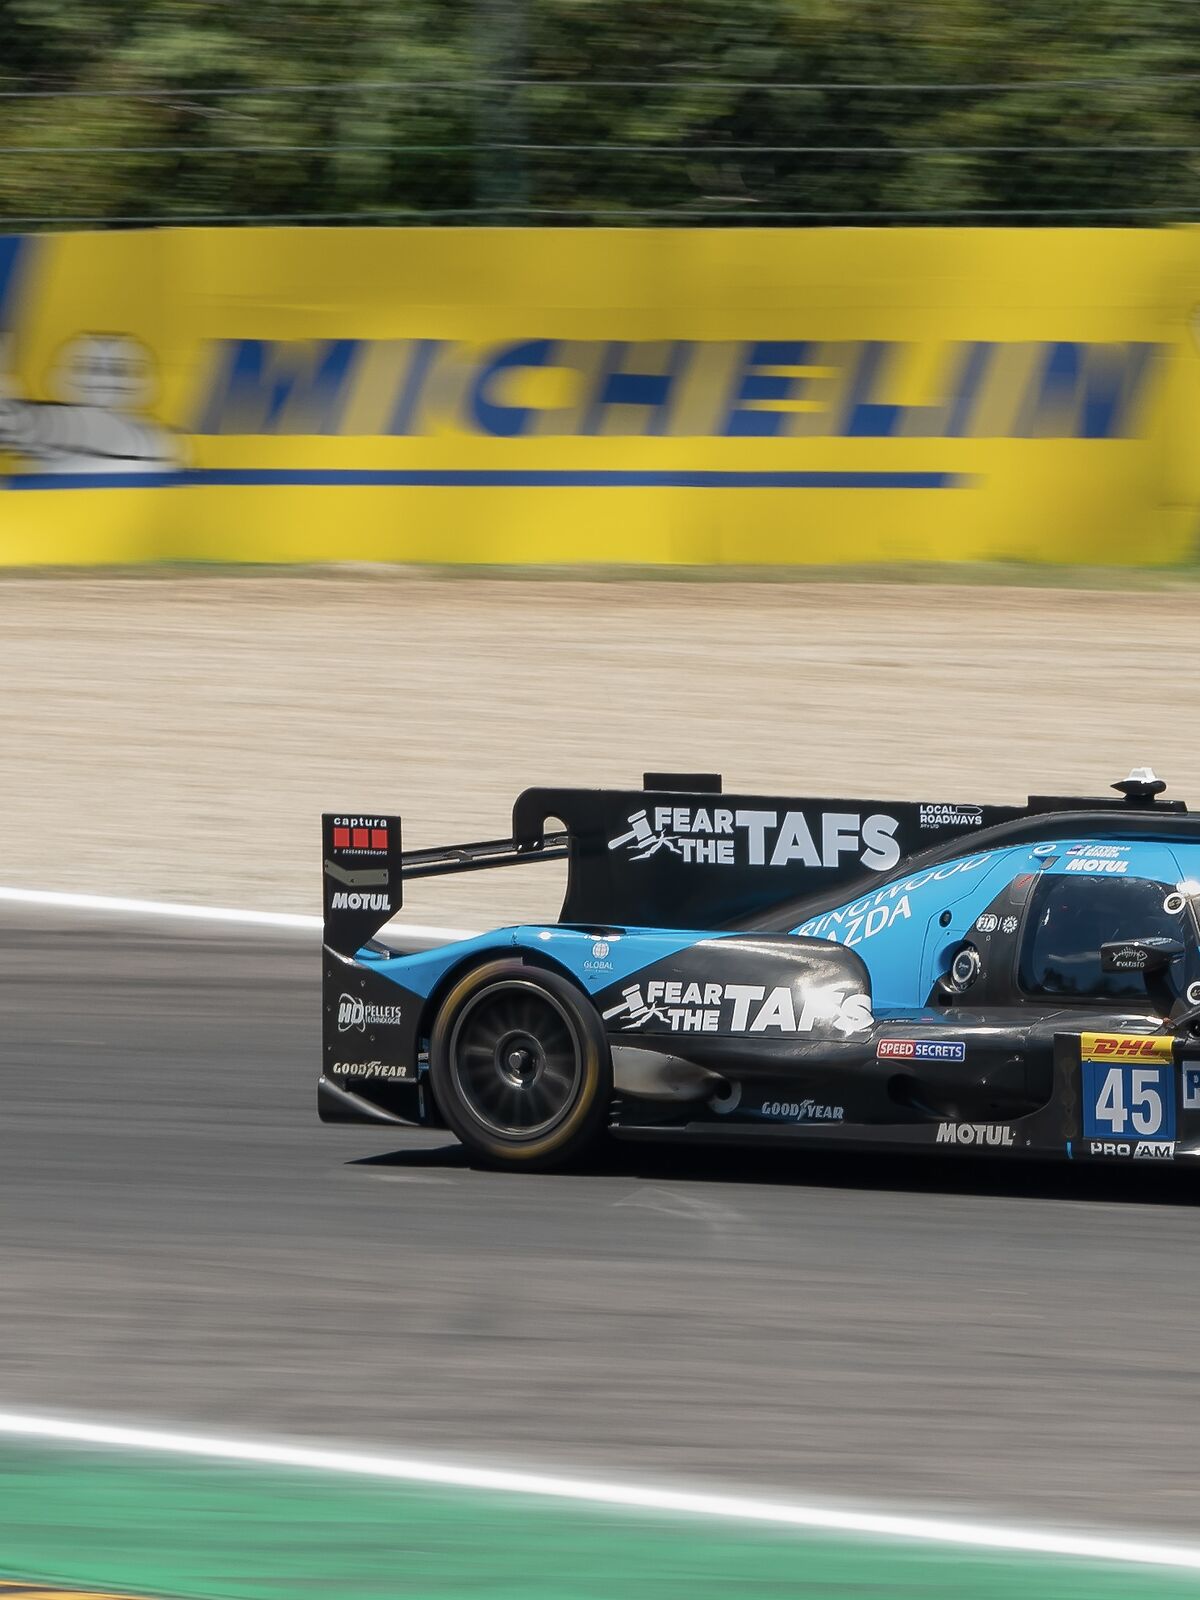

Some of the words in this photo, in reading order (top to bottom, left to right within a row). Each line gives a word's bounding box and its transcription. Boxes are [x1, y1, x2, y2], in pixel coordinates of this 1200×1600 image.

[201, 338, 1172, 438] MICHELIN
[919, 804, 956, 815] LOCAL
[333, 816, 388, 828] captura
[919, 814, 982, 825] ROADWAYS
[654, 806, 735, 834] FEAR
[735, 809, 901, 872] TAFS
[677, 838, 736, 865] THE
[1064, 858, 1130, 874] MOTUL
[331, 892, 392, 911] MOTUL
[826, 894, 912, 947] AZDA
[978, 915, 997, 930] FIA
[583, 960, 614, 970] GLOBAL
[337, 1003, 365, 1024] HD
[365, 1005, 402, 1018] PELLETS
[647, 981, 724, 1006] FEAR
[724, 984, 876, 1037] TAFS
[667, 1008, 721, 1032] THE
[880, 1043, 914, 1055] SPEED
[915, 1044, 962, 1058] SECRETS
[1093, 1038, 1161, 1057] DHL
[333, 1060, 407, 1079] GOODYEAR
[761, 1099, 844, 1120] GOODYEAR
[1095, 1068, 1163, 1136] 45
[935, 1122, 1015, 1146] MOTUL
[1090, 1141, 1131, 1157] PRO
[1139, 1144, 1172, 1158] AM
